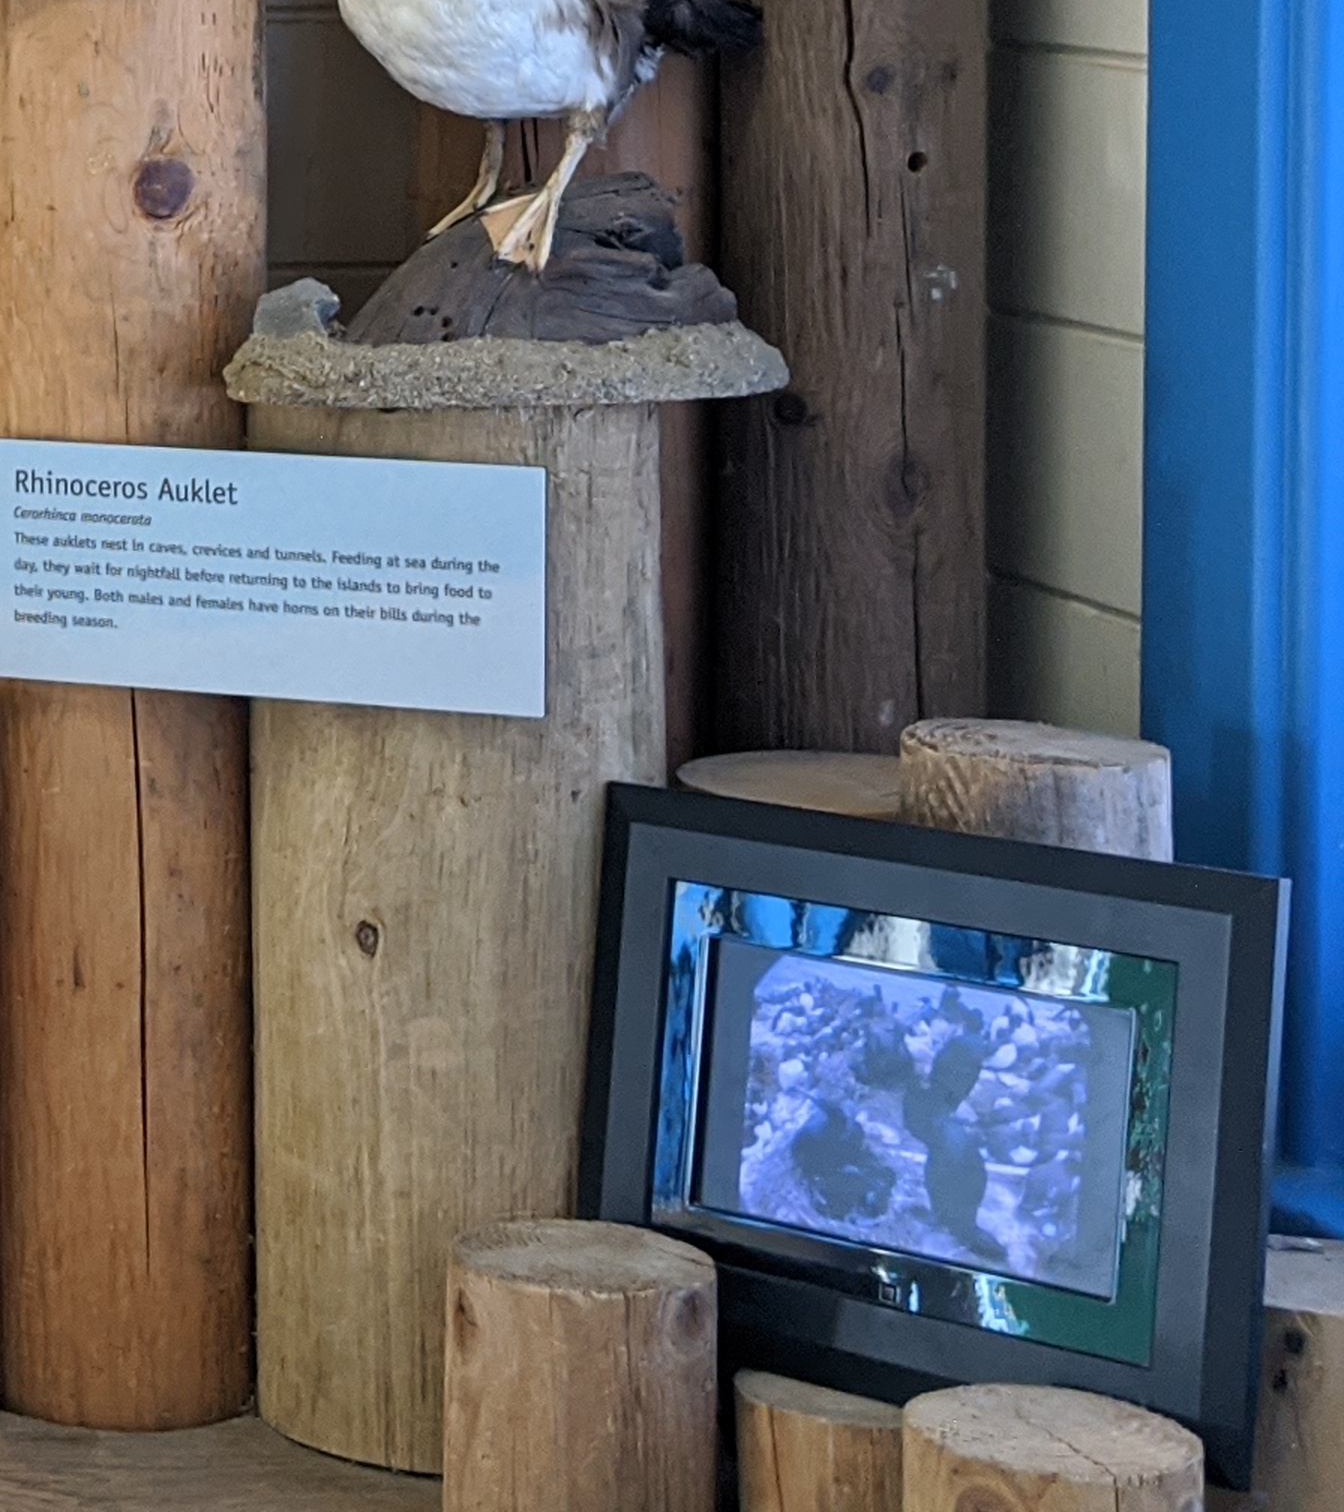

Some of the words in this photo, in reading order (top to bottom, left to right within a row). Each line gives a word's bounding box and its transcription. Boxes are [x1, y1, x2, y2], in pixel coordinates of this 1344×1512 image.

[16, 470, 147, 499] Rhinoceros
[158, 478, 237, 505] Auklet
[14, 583, 43, 598] their
[94, 589, 124, 602] Both
[128, 592, 164, 606] males
[168, 594, 191, 607] and
[196, 595, 244, 611] females
[249, 598, 279, 613] have
[323, 606, 340, 617] on
[344, 604, 376, 619] their
[380, 607, 408, 621] bills
[412, 610, 454, 628] during
[459, 612, 481, 626] the
[14, 609, 67, 629] breeding
